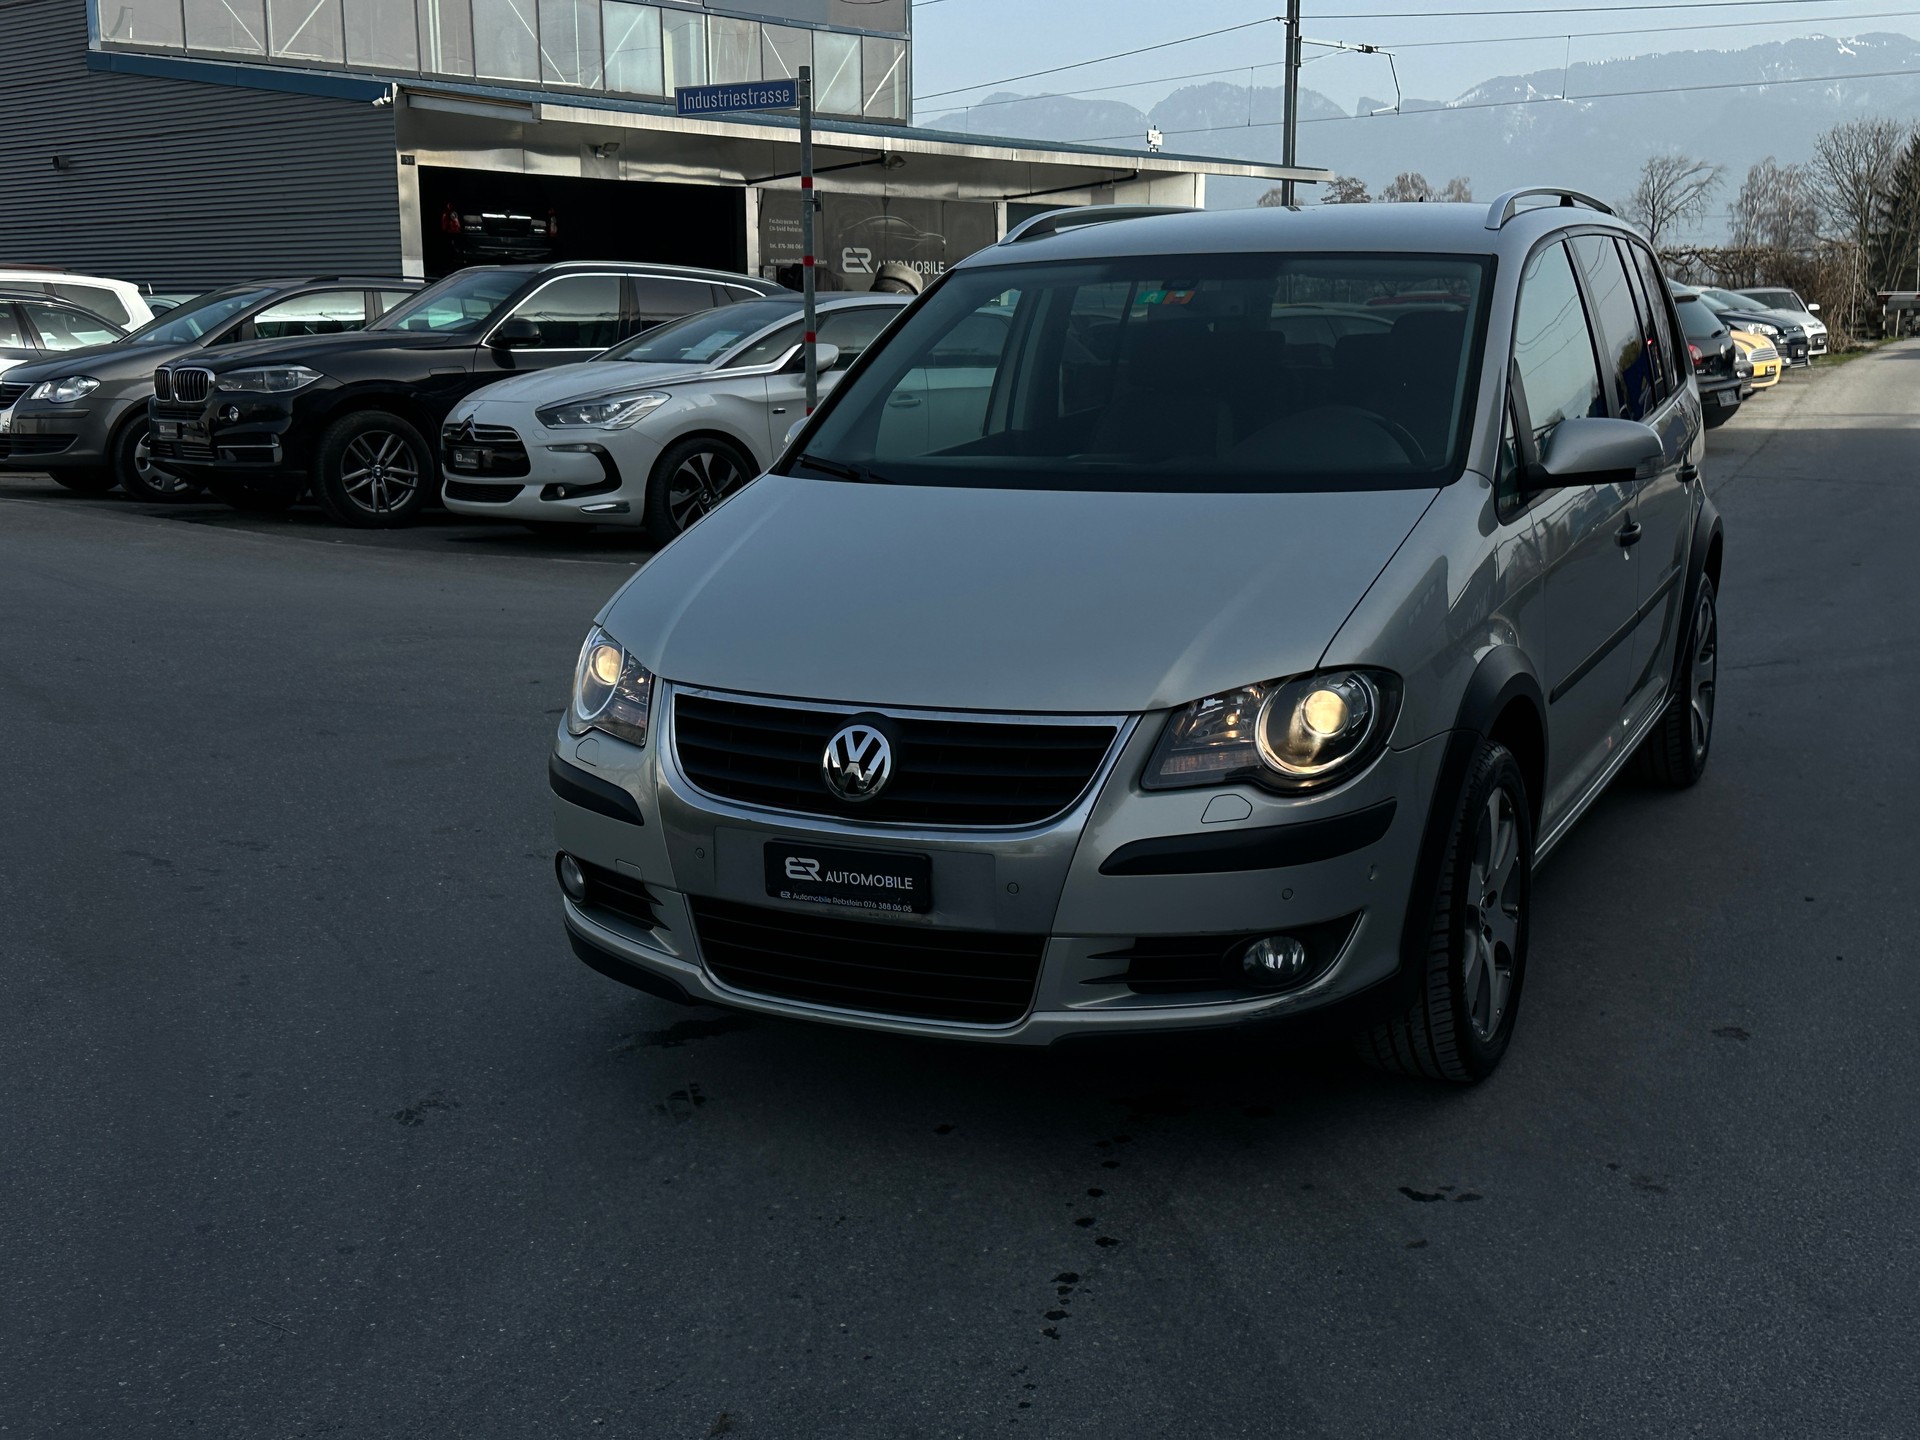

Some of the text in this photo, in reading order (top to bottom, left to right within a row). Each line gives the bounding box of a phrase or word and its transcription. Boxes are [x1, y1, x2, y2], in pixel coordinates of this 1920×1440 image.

[683, 88, 790, 110] Industriestrasse
[841, 247, 873, 273] ER
[785, 856, 914, 890] ER AUTOMOBILE
[792, 893, 832, 904] Automobile
[832, 897, 863, 908] Rebstein
[863, 900, 877, 909] 076
